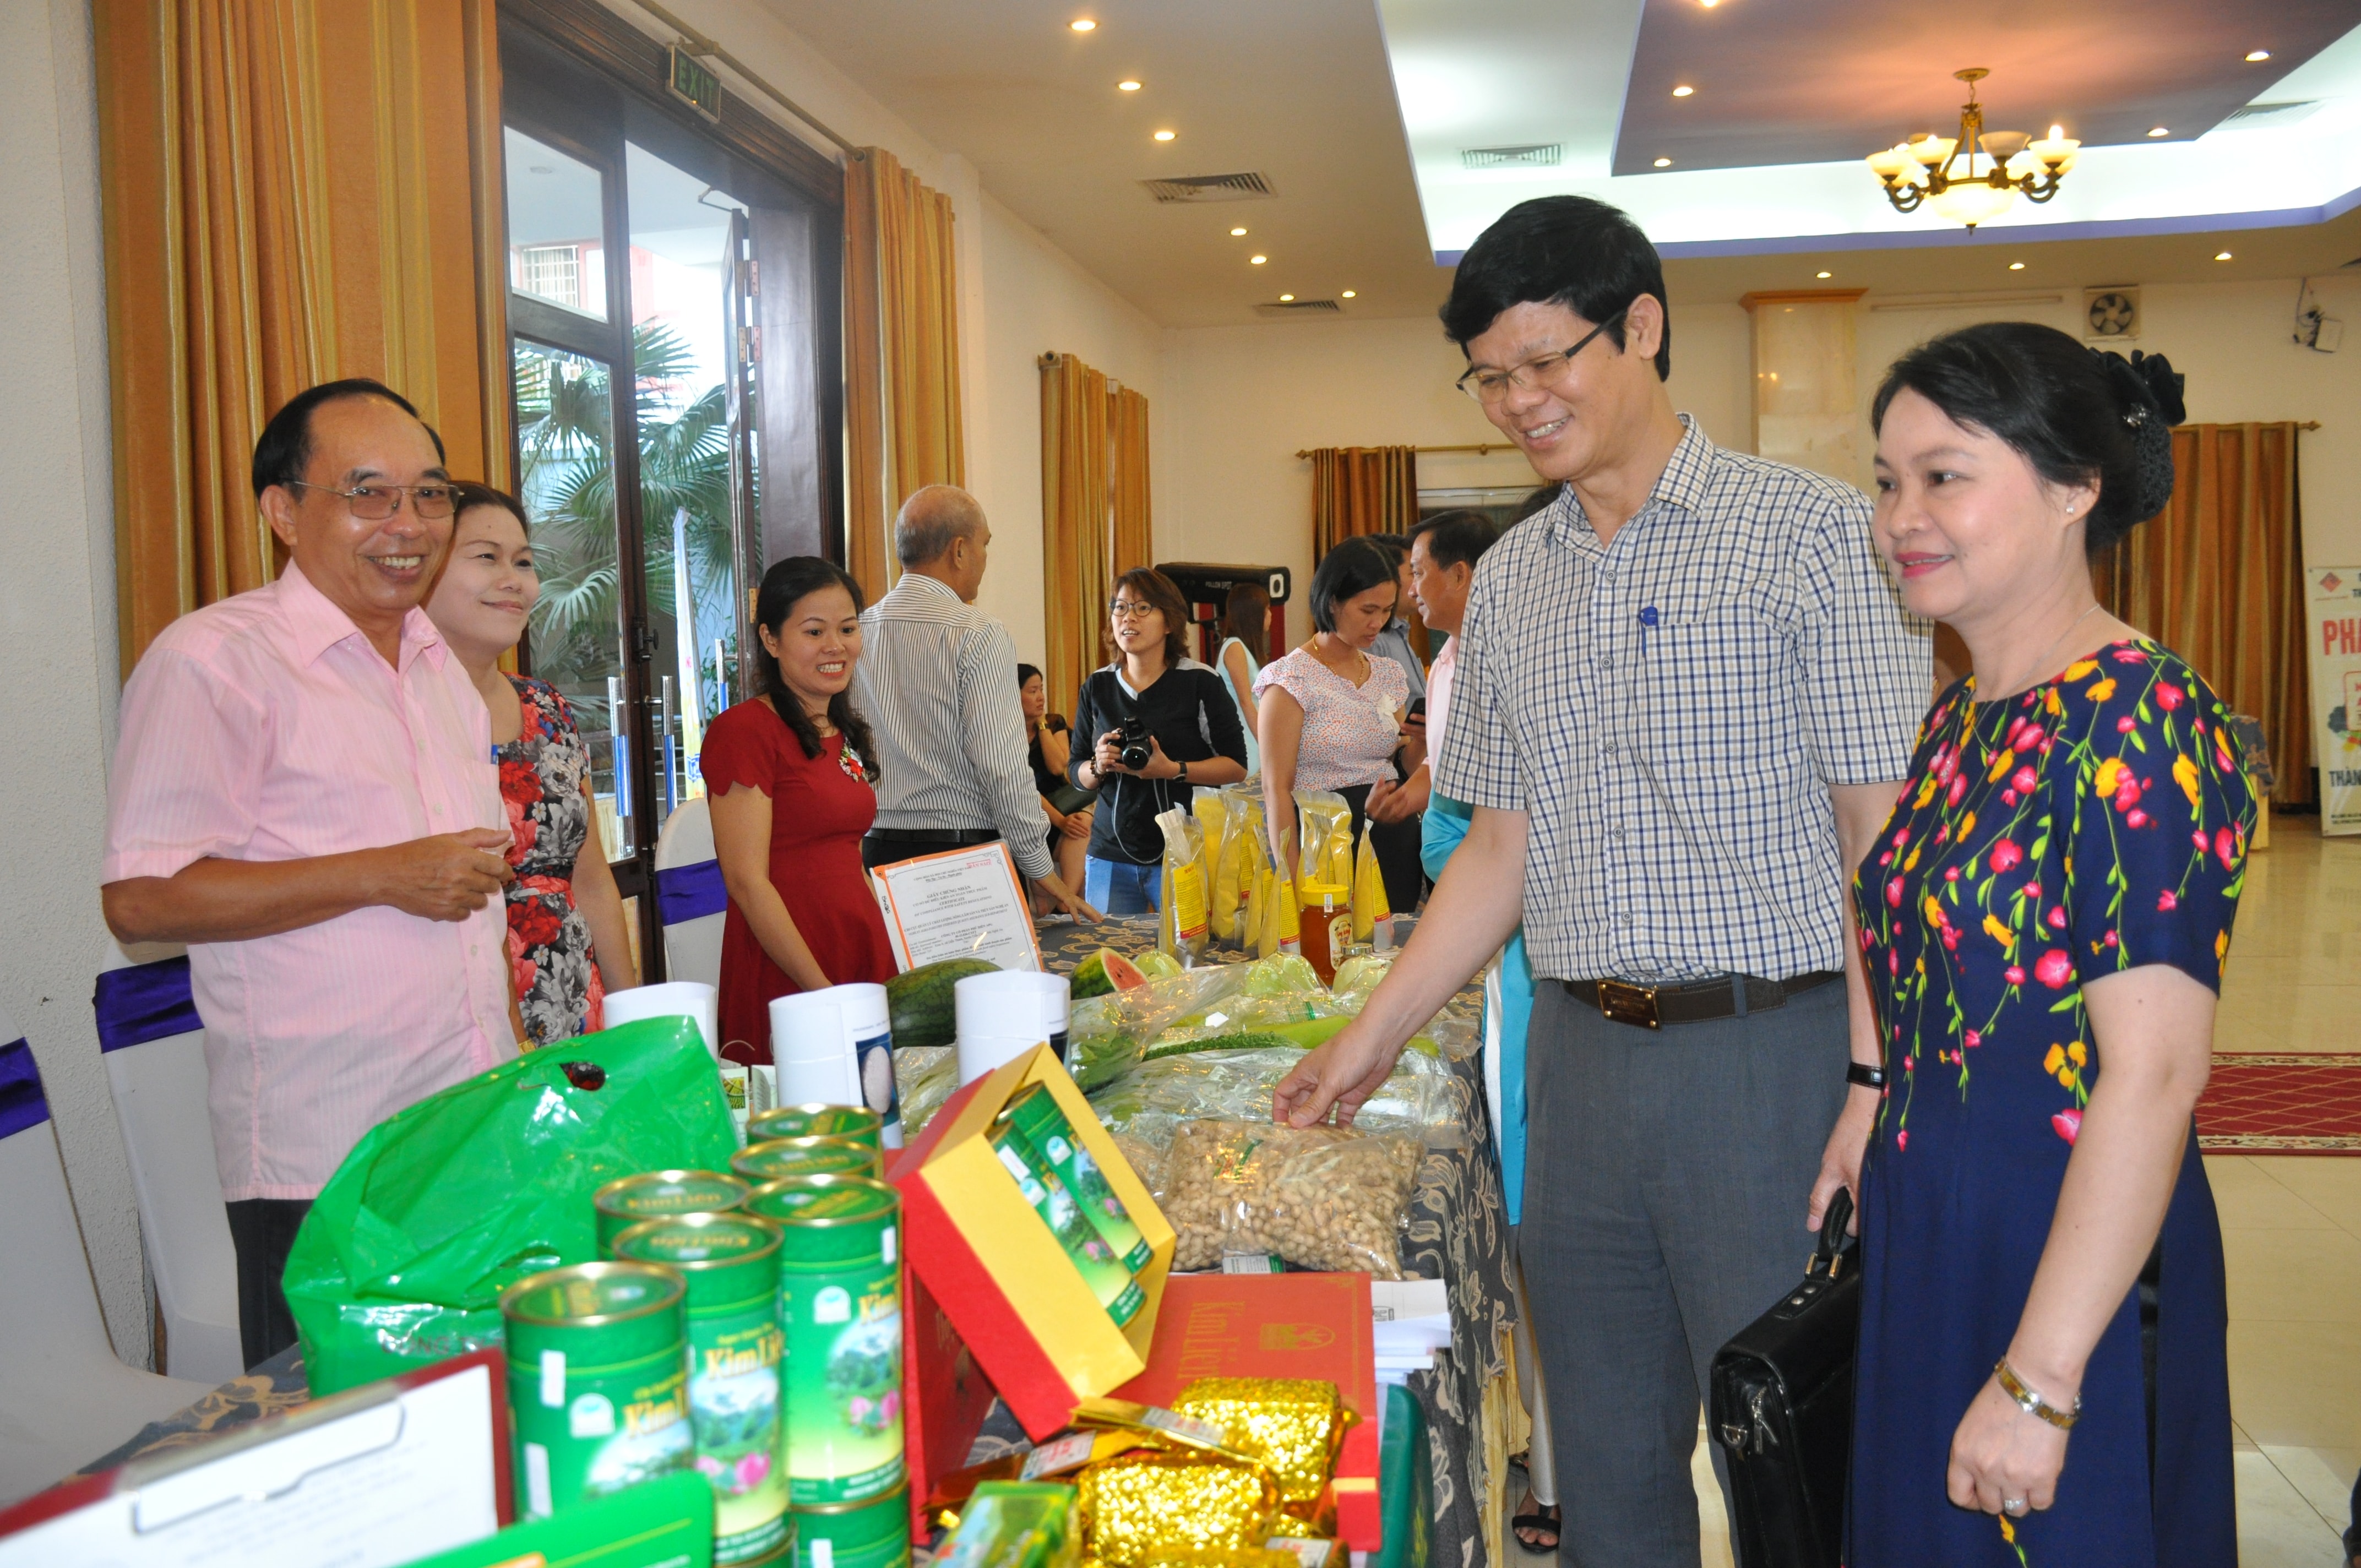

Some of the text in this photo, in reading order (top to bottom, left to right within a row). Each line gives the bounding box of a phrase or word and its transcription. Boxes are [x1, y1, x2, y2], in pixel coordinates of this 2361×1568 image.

[678, 56, 714, 109] EXIT
[2322, 617, 2361, 656] PH
[939, 897, 965, 906] CERTIFICATE
[705, 1347, 758, 1381] Kim
[623, 1400, 676, 1439] Kim
